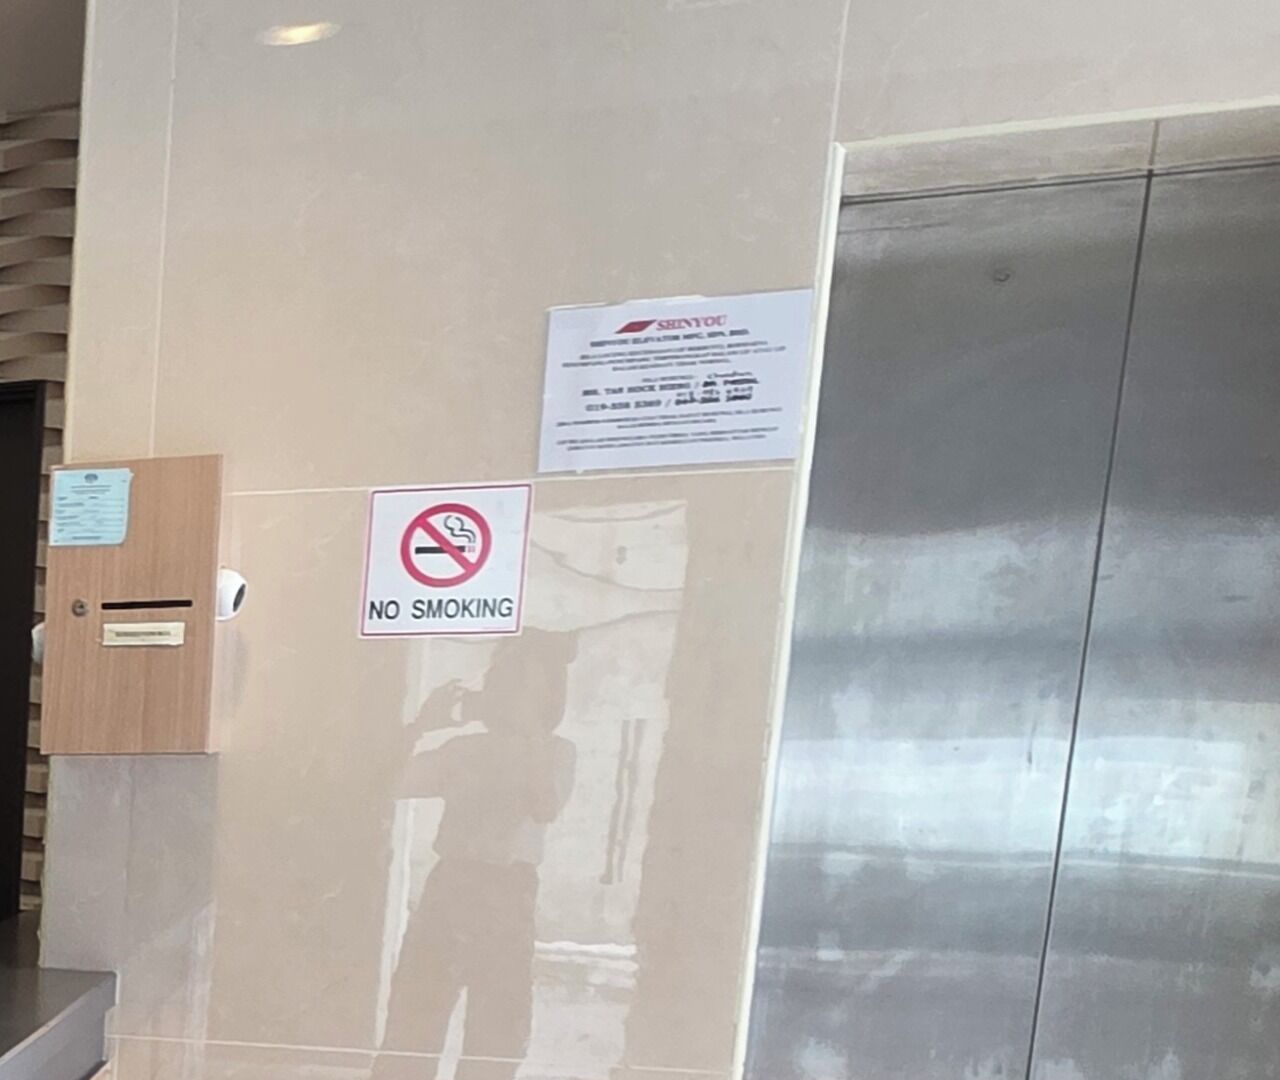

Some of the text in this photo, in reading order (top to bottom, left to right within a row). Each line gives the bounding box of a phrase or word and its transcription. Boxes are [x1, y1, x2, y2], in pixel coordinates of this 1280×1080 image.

[656, 315, 728, 331] SHINYOU
[368, 598, 514, 620] NO SMOKING
